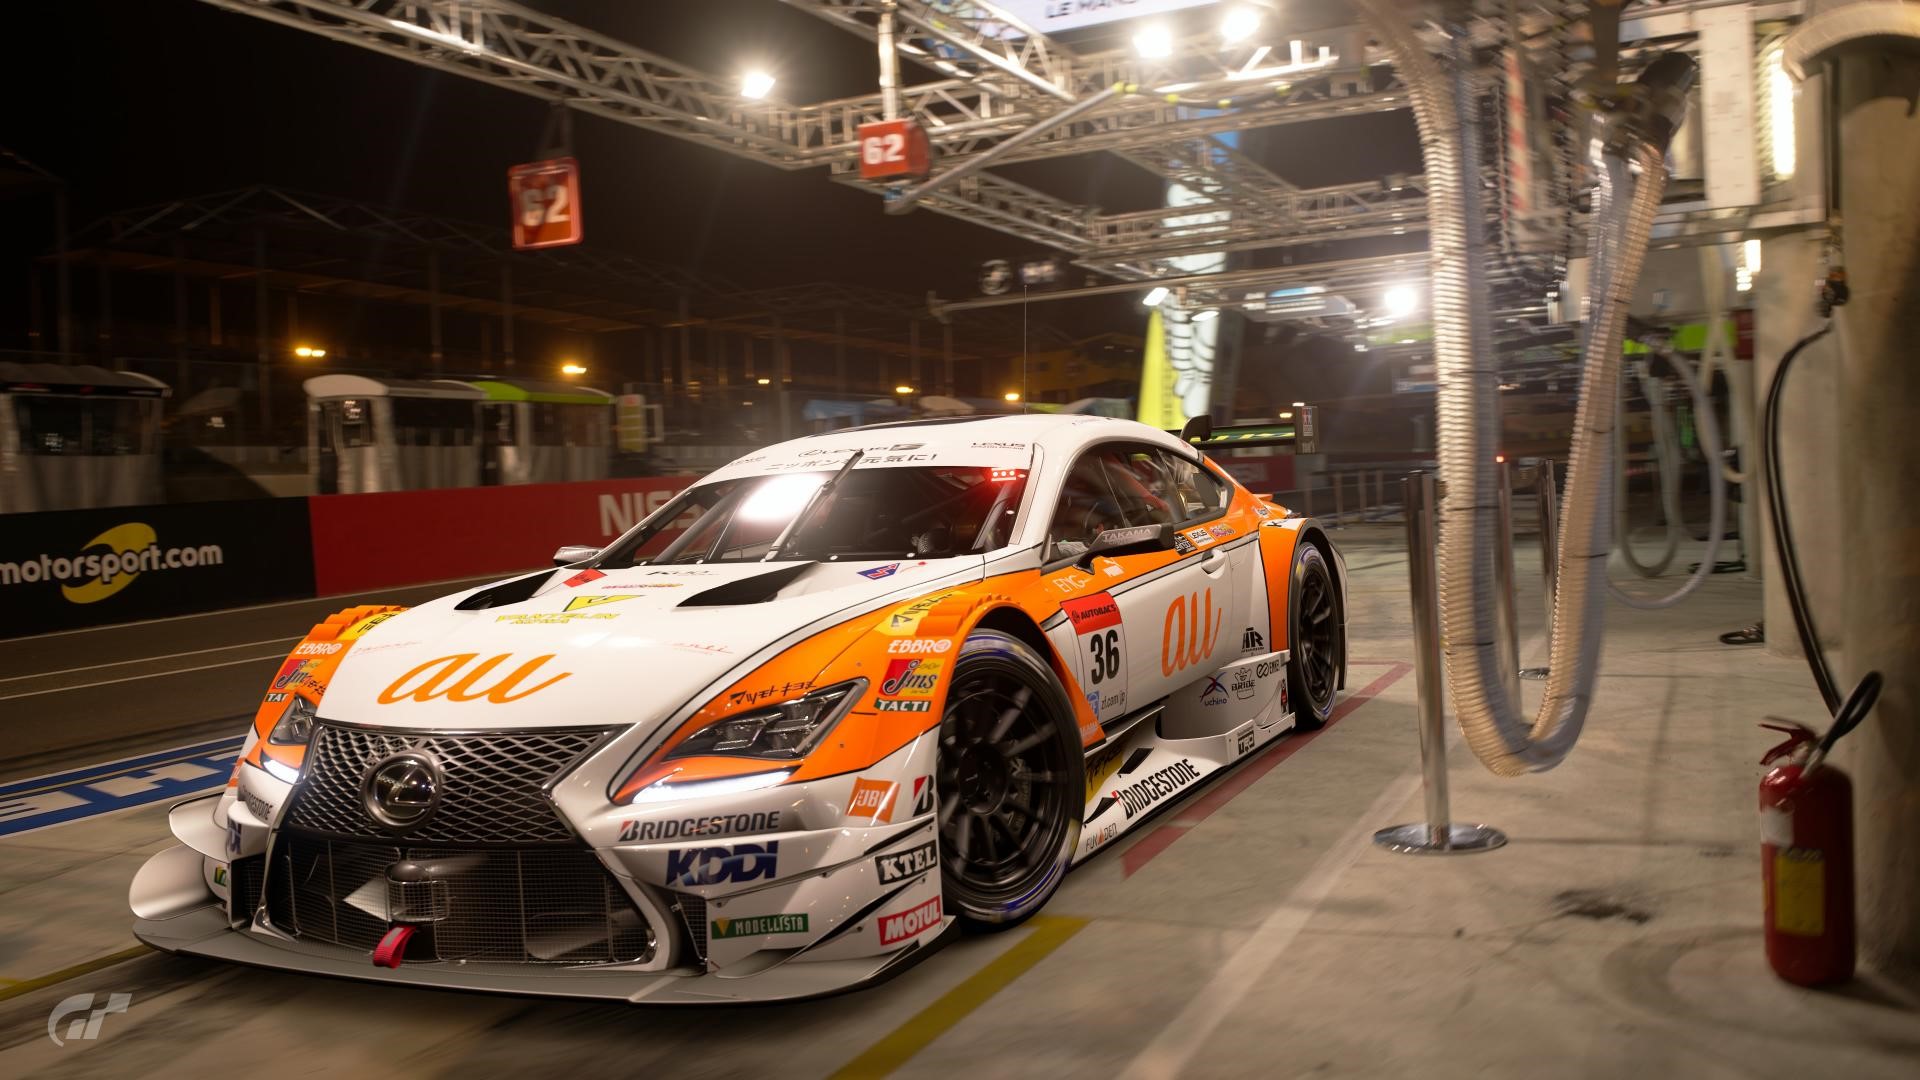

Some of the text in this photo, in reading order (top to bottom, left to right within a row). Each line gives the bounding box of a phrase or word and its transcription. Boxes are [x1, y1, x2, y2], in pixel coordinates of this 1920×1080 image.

[862, 133, 905, 165] 62
[521, 185, 571, 226] 62
[0, 544, 223, 585] motorsport.com
[1080, 604, 1117, 620] AUTOBACS
[886, 639, 952, 654] EBBRO
[1161, 586, 1222, 678] au
[295, 643, 342, 655] EBBRO
[1090, 629, 1120, 685] 36
[376, 651, 573, 705] au
[1231, 679, 1256, 692] BRIDE
[878, 699, 930, 712] TACTI
[1204, 698, 1228, 706] uchino
[1111, 758, 1201, 820] BRIDGESTONE
[619, 810, 780, 842] BRIDGESTONE
[664, 840, 779, 888] KDDI
[880, 846, 937, 881] KTEL
[735, 915, 805, 935] MODELLISTA
[884, 906, 940, 943] MOTUL
